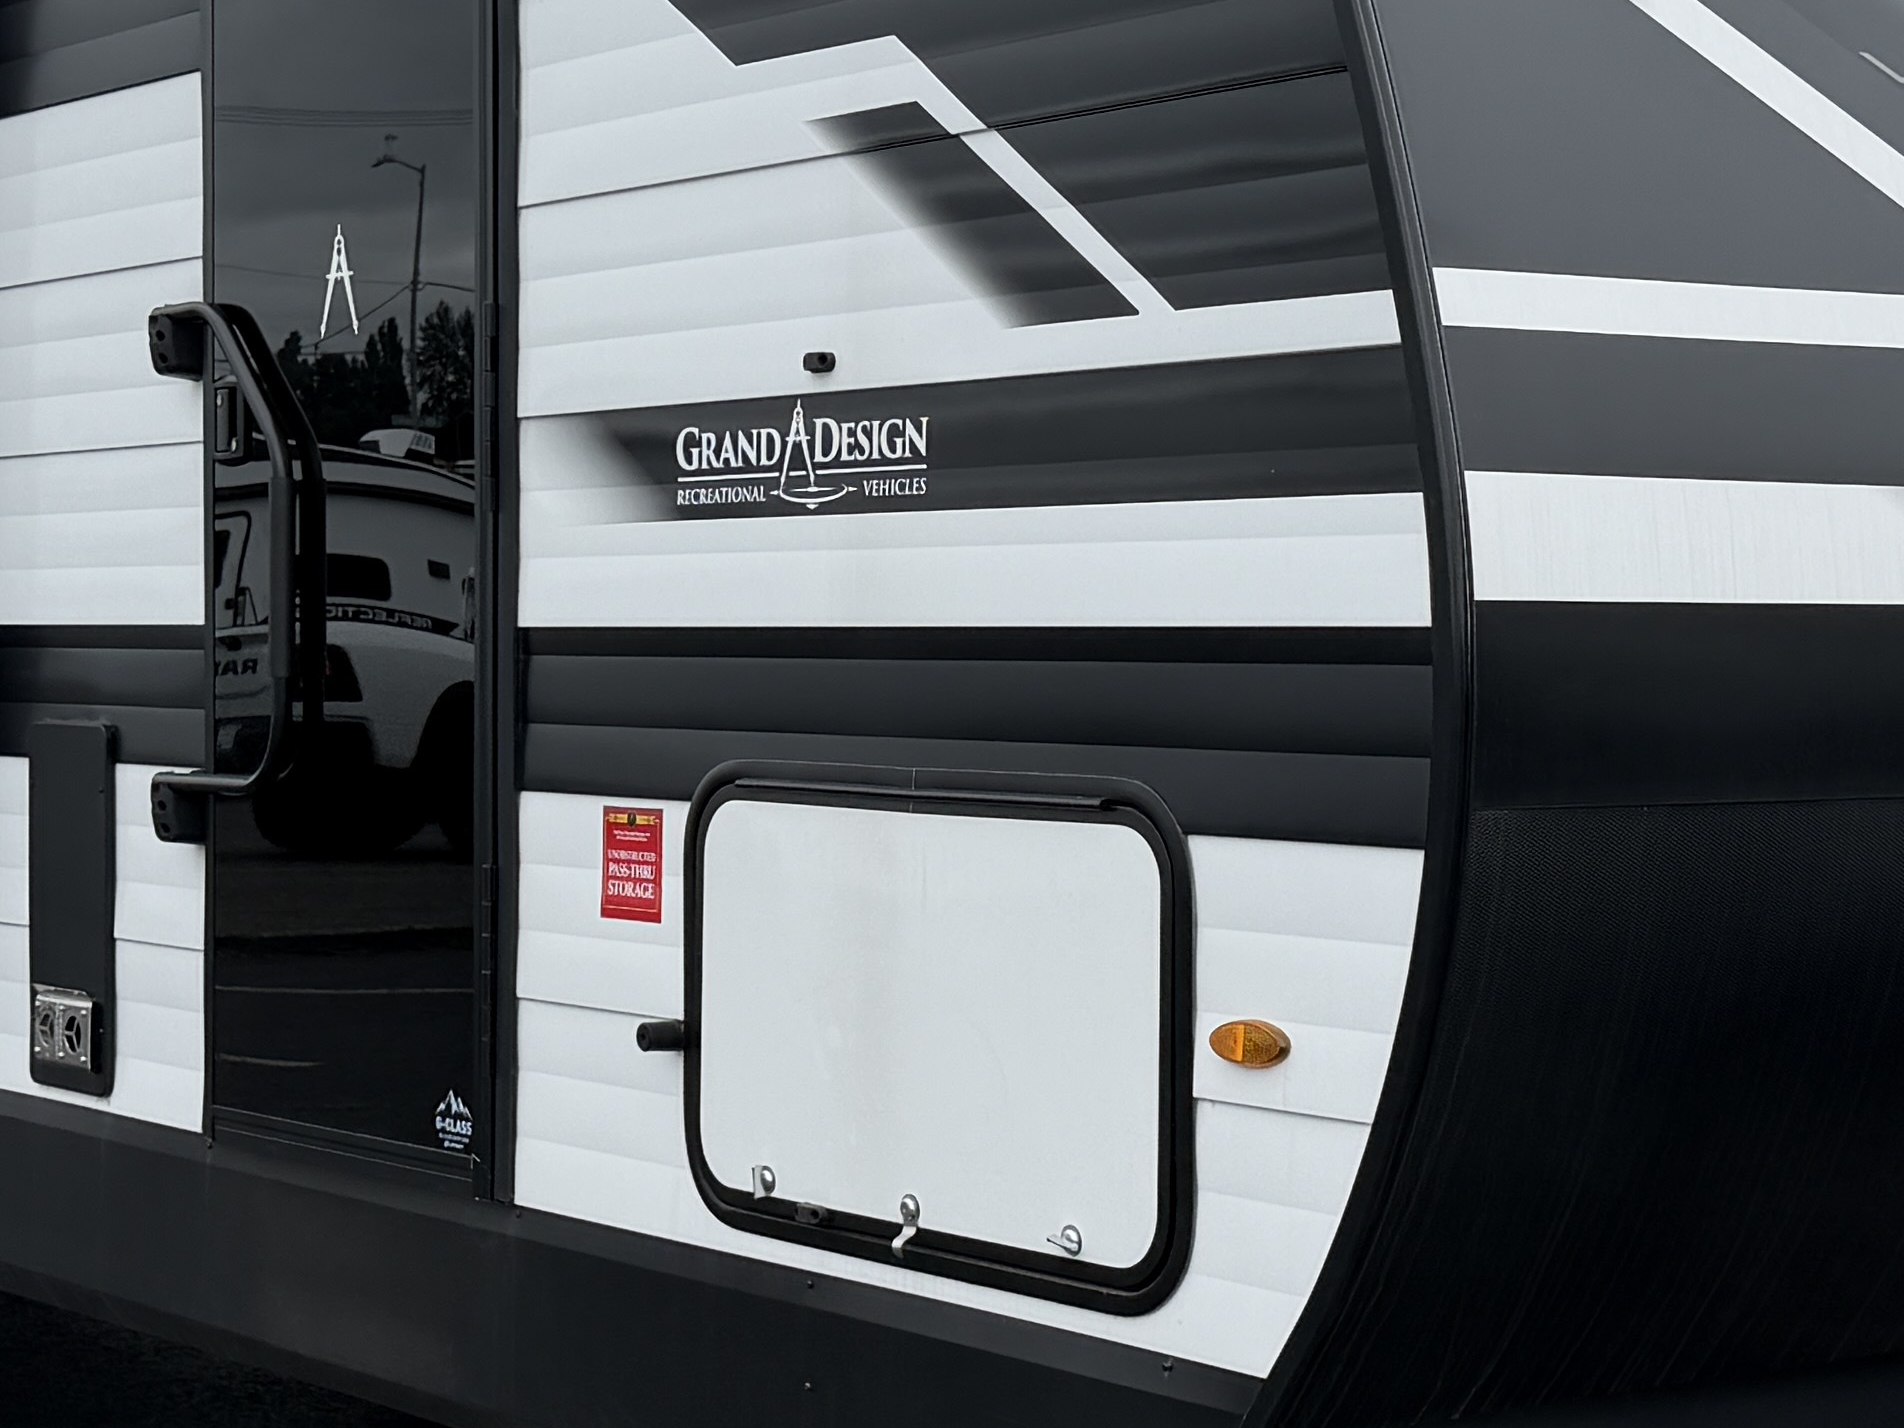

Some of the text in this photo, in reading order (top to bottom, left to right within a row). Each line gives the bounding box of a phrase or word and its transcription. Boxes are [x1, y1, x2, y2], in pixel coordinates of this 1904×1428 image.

[676, 416, 929, 471] GRAND DESIGN
[677, 477, 927, 506] RECREATIONAL VEHICLES
[608, 862, 656, 880] PASS-THRU
[608, 880, 655, 899] STORAGE
